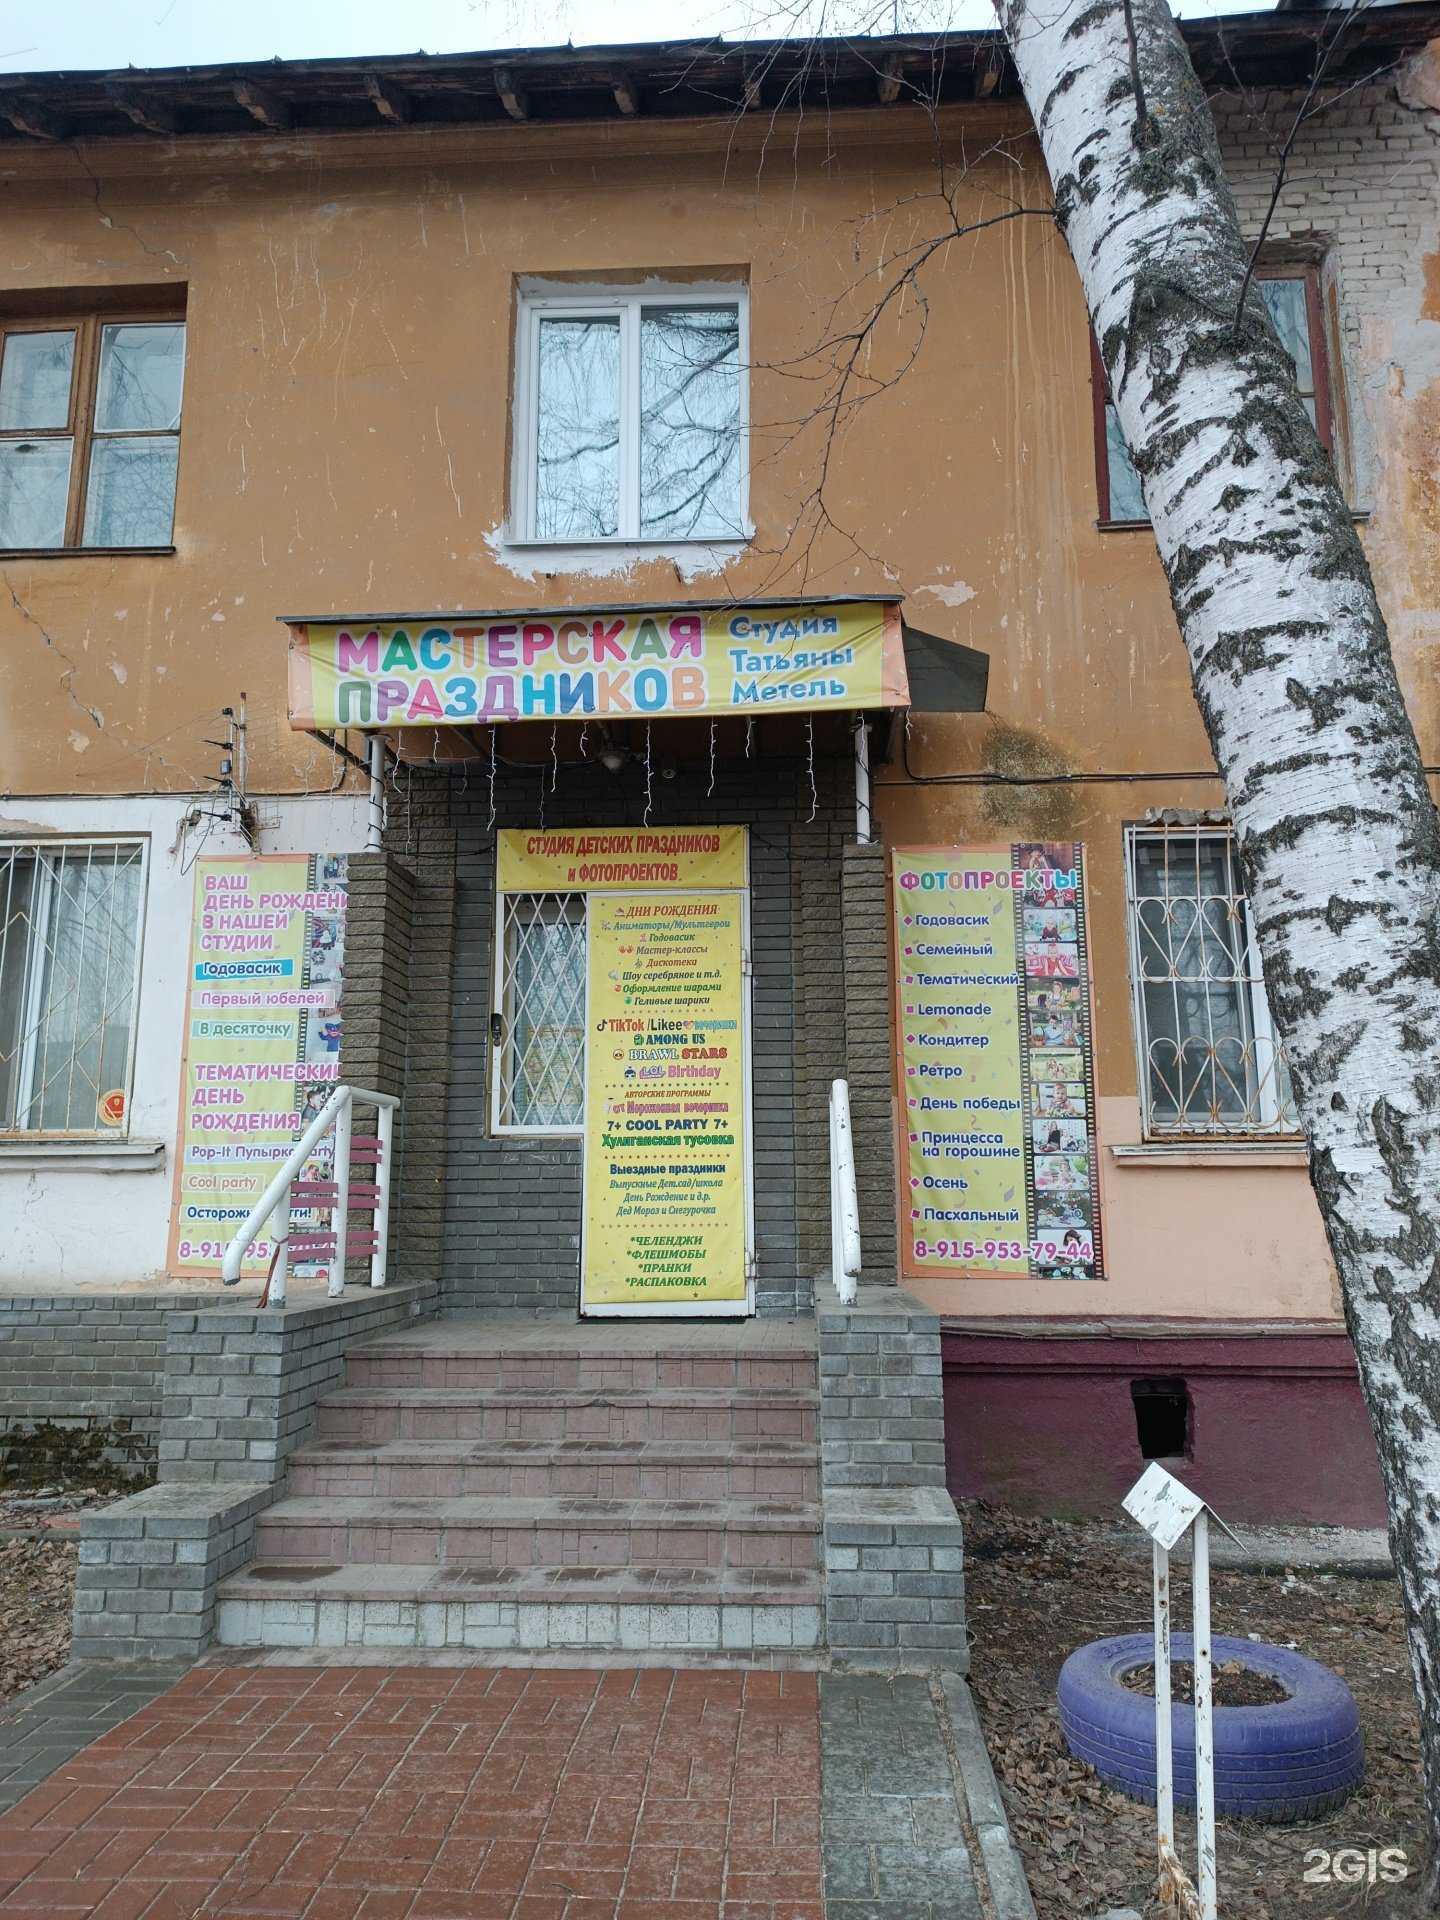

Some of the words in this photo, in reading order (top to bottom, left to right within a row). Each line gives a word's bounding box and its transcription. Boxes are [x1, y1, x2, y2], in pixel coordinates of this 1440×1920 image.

[729, 616, 837, 644] Студия
[337, 616, 702, 673] МАСТЕРСКАЯ
[729, 648, 852, 673] Татьяны
[337, 666, 707, 723] ПРАЗДНИКОВ
[732, 679, 845, 704] Метель
[527, 836, 574, 857] СТУДИЯ
[576, 835, 632, 857] ДЕТСКИХ
[636, 834, 720, 856] ПРАЗДНИКОВ
[579, 863, 679, 882] ФОТОПРОЕКТОВ
[205, 876, 247, 890] ВАШ
[900, 870, 1077, 890] ФОТОПРОЕКТЫ
[204, 894, 254, 911] ДЕНЬ
[259, 893, 348, 910] РОЖДЕНИ
[626, 906, 651, 918] ДНИ
[653, 904, 718, 916] РОЖДЕНИЯ
[202, 915, 210, 928] В
[219, 910, 288, 929] НАШЕЙ
[915, 914, 990, 927] Годовасик
[201, 935, 273, 951] СТУДИИ
[649, 933, 695, 942] Годовасик
[636, 946, 708, 956] Мастер-классы
[916, 943, 993, 955] Семейный
[204, 963, 280, 975] Годовасик
[646, 959, 697, 968] Дискотека
[622, 972, 641, 981] Шоу
[644, 971, 695, 981] серебряное
[917, 972, 1019, 985] Тематический
[623, 984, 681, 995] Оформление
[684, 984, 721, 993] шарами
[201, 992, 261, 1007] Первый
[266, 991, 325, 1004] юбелей
[675, 997, 710, 1006] шарики
[918, 1003, 992, 1015] Lemonade
[200, 1023, 208, 1034] В
[213, 1023, 290, 1037] десяточку
[608, 1019, 644, 1032] TikTok
[646, 1034, 688, 1045] AMONG
[692, 1034, 706, 1044] US
[918, 1034, 989, 1048] Кондитер
[629, 1048, 679, 1060] BRAWL
[681, 1047, 728, 1059] STARS
[668, 1065, 721, 1079] Birthday
[919, 1064, 963, 1079] Ретро
[192, 1088, 244, 1106] ДЕНЬ
[666, 1090, 711, 1098] ПРОГРАММЫ
[920, 1096, 958, 1110] День
[963, 1096, 1021, 1110] победы
[192, 1113, 300, 1131] РОЖДЕНИЯ
[608, 1121, 621, 1131] 7+
[626, 1120, 662, 1130] COOL
[665, 1119, 708, 1130] PARTY
[714, 1119, 728, 1129] 7+
[684, 1135, 734, 1148] тусовка
[922, 1131, 1003, 1145] Принцесса
[192, 1146, 231, 1161] Pop-It
[307, 1144, 335, 1159] arty
[922, 1146, 940, 1157] на
[945, 1145, 1020, 1159] горошине
[610, 1164, 666, 1175] Выездные
[669, 1164, 725, 1175] праздники
[189, 1176, 216, 1188] Cool
[222, 1177, 256, 1191] party
[610, 1180, 656, 1190] Выпускные
[923, 1176, 968, 1189] Осень
[623, 1193, 643, 1203] День
[187, 1207, 250, 1221] Осторож
[616, 1206, 632, 1217] Дед
[633, 1206, 659, 1217] Мороз
[668, 1206, 716, 1216] Снегурочка
[924, 1207, 1019, 1221] Пасхальный
[915, 1241, 1092, 1259] 8-915-953-79-44
